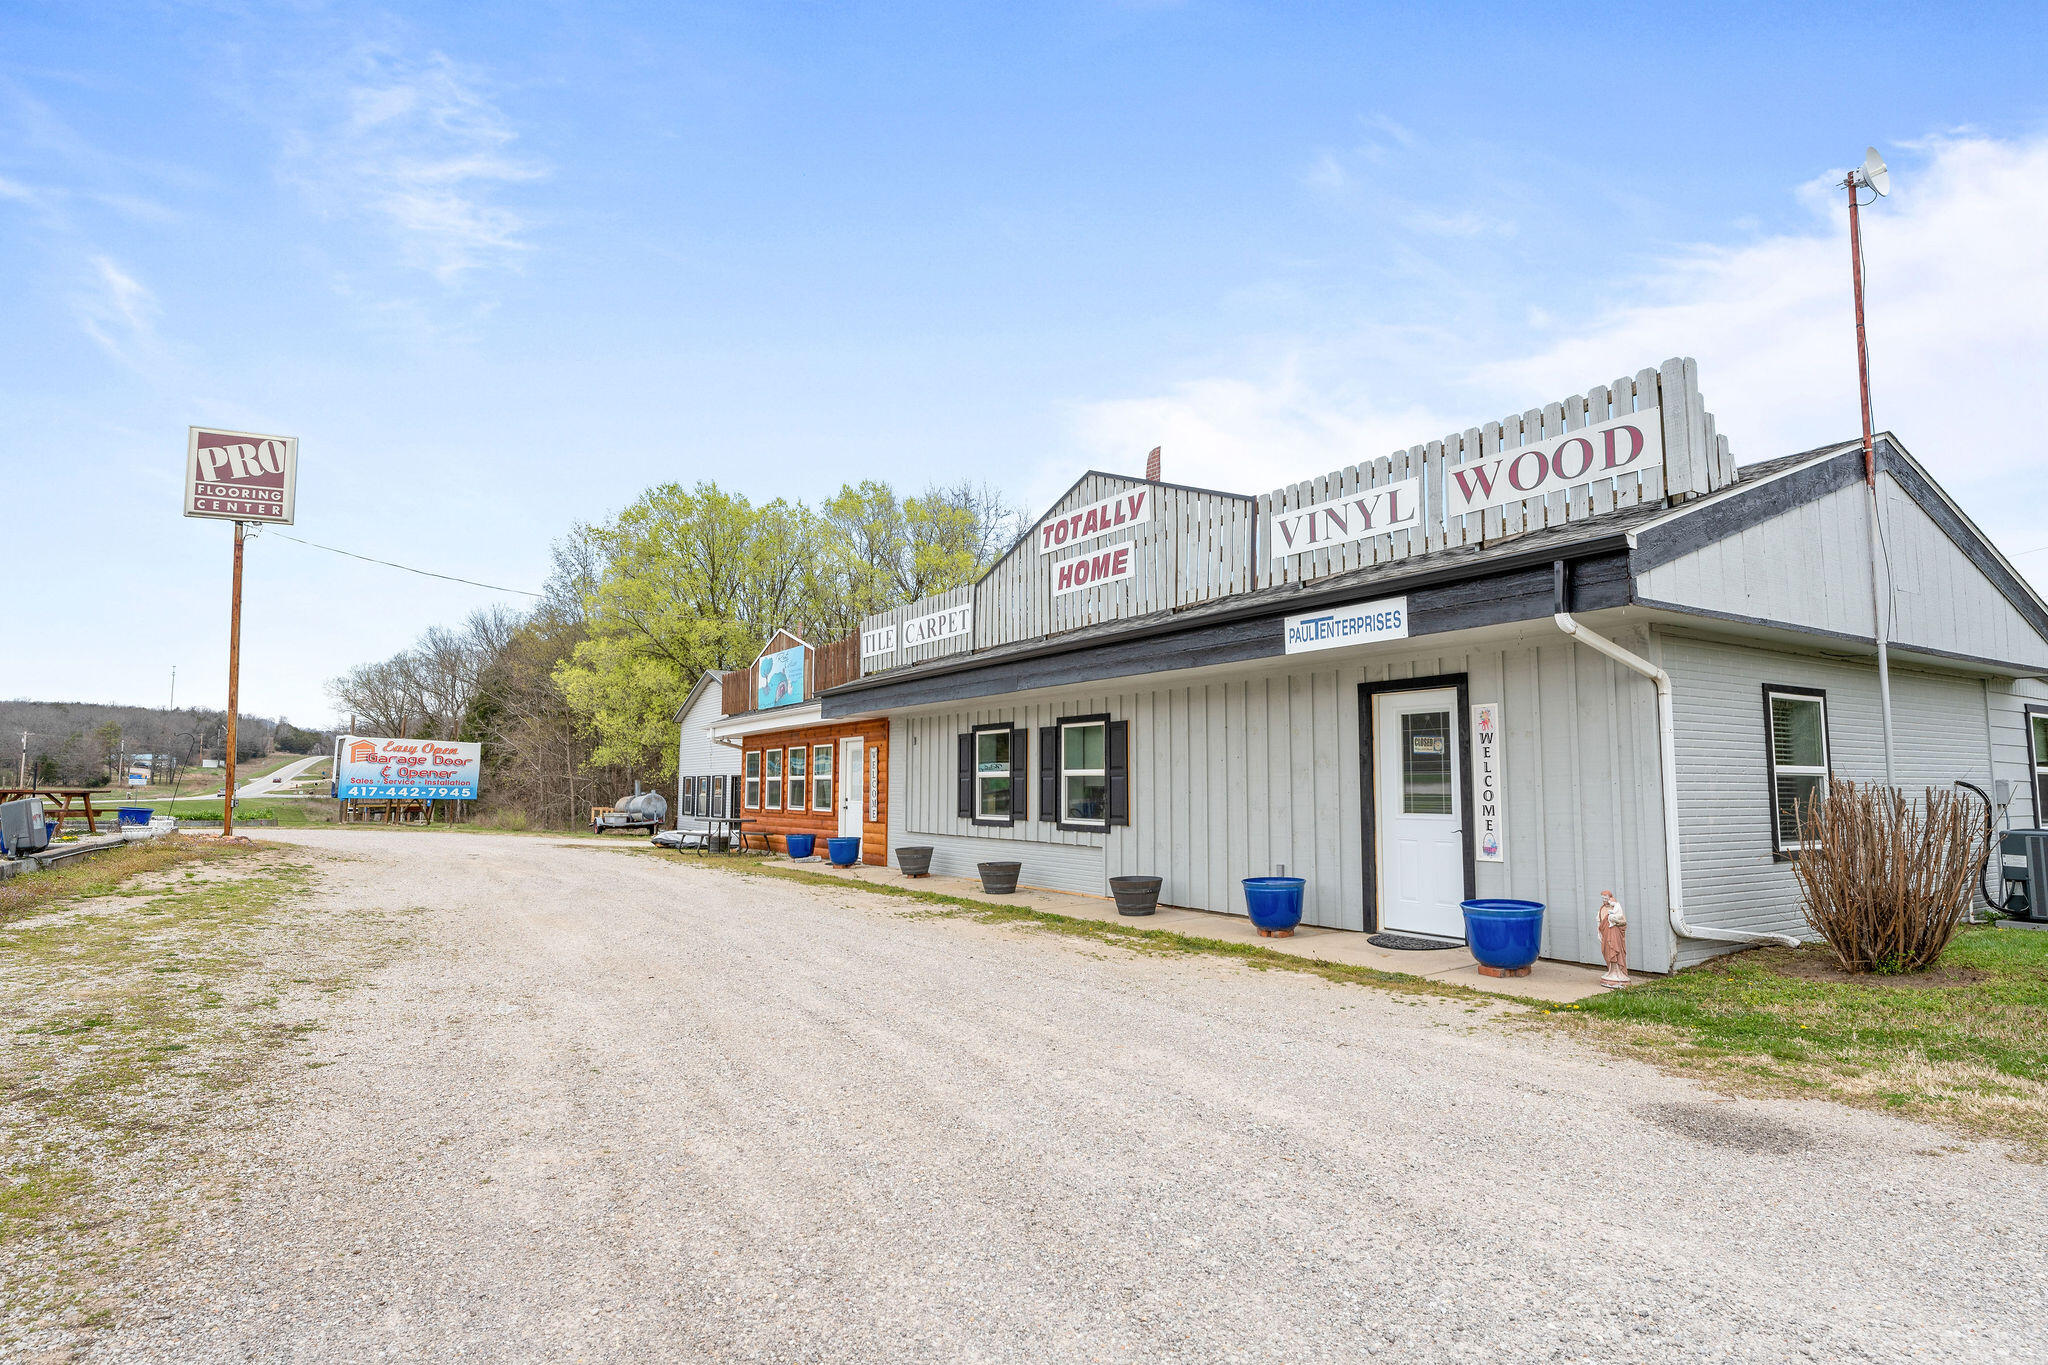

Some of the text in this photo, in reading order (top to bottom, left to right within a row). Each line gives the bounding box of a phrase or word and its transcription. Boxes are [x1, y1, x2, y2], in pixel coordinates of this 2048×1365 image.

[198, 439, 286, 482] PRO
[1453, 425, 1644, 505] WOOD
[197, 485, 281, 500] FLOORING
[196, 499, 281, 515] CENTER
[1043, 491, 1146, 548] TOTALLY
[1278, 489, 1415, 550] VINYL
[1058, 548, 1129, 591] HOME
[905, 608, 970, 644] CARPET
[863, 629, 894, 654] TILE
[367, 752, 473, 767] Garage Door
[383, 740, 459, 756] Easy Open
[350, 777, 374, 785] Sales
[383, 778, 415, 786] Service
[424, 778, 471, 786] Installation
[398, 767, 458, 779] Opener
[1479, 732, 1496, 832] WELCOME
[348, 786, 471, 797] 417-442-7945
